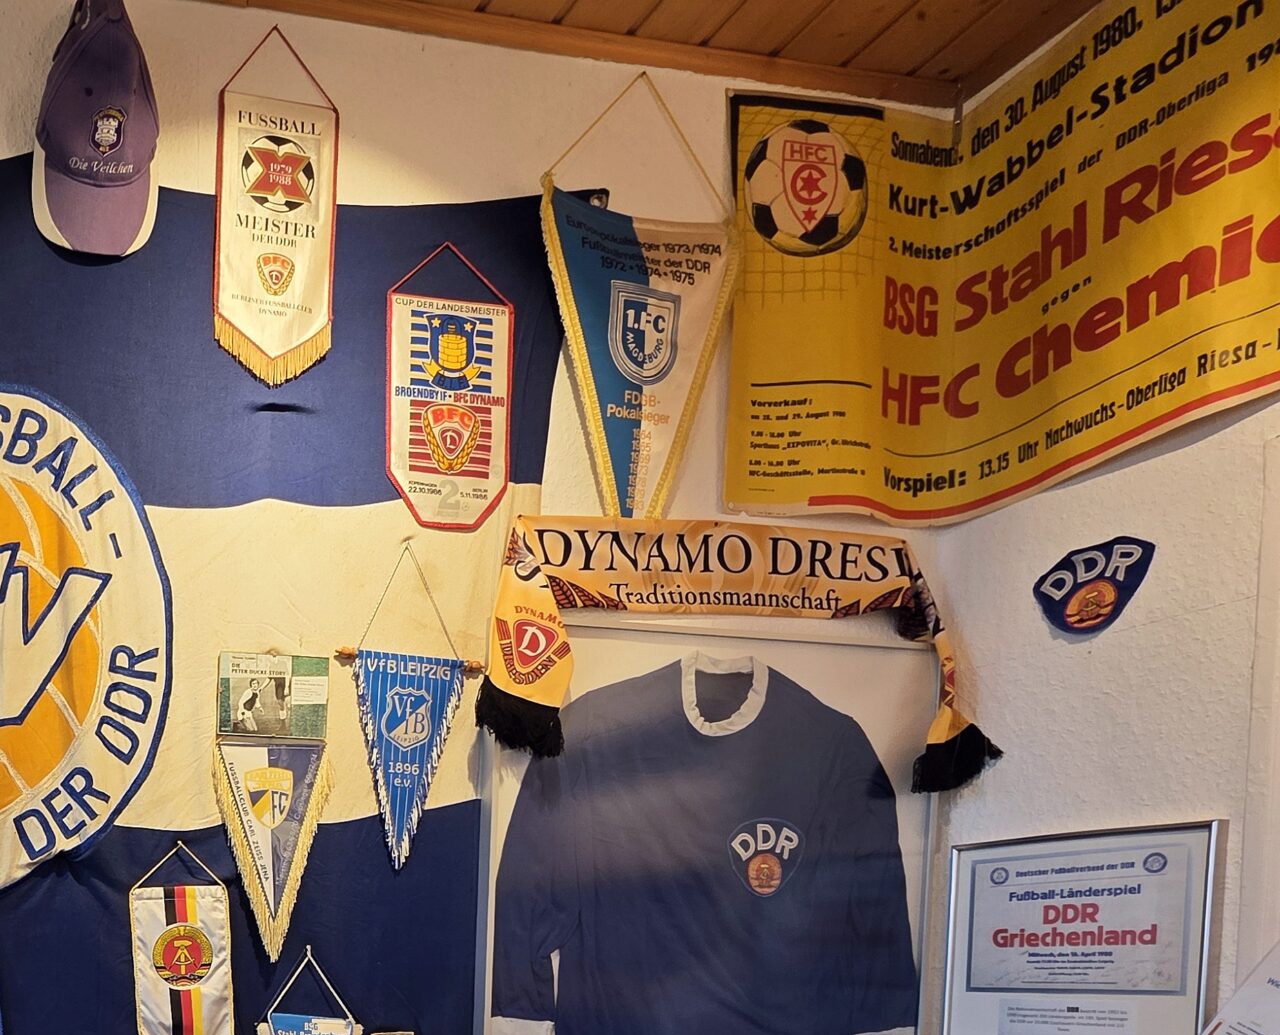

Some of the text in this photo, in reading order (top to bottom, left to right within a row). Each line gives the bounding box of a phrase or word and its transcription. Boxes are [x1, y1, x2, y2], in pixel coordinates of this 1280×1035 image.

[972, 118, 1000, 156] den
[1004, 100, 1028, 134] 30.
[1031, 46, 1087, 112] August
[1093, 6, 1143, 61] 1980,
[237, 109, 321, 136] FUSSBALL
[69, 157, 134, 174] Die Veilchen
[789, 143, 828, 162] HFC
[889, 237, 898, 253] 2.
[902, 168, 1065, 260] Meisterschaftsspiel
[1078, 149, 1103, 175] der
[1115, 71, 1229, 151] DDR-Oberliga
[269, 163, 292, 175] 1979
[269, 174, 292, 185] 1988
[235, 213, 316, 239] MEISTER
[883, 113, 1280, 338] BSG Stahl Ries
[252, 233, 297, 248] DER DDR
[664, 258, 711, 274] der DDR
[395, 297, 507, 317] CUP DER LANDESMEISTER
[1041, 274, 1093, 316] gegen
[395, 386, 505, 407] BROENDBY IF BFC DYNAMO
[881, 362, 980, 426] HFC
[433, 406, 473, 426] BFC
[606, 403, 671, 426] Pokalsieger
[883, 466, 968, 498] Vorspiel:
[978, 450, 1010, 481] 13.15
[1017, 439, 1040, 464] Uhr
[1044, 366, 1189, 451] Nachwuchs-Oberliga
[1196, 338, 1257, 379] Riesa
[533, 527, 753, 578] DYNAMO
[1040, 544, 1143, 601] DDR
[609, 582, 842, 613] Traditionsmannschaft
[514, 603, 566, 630] DYNAMO
[366, 657, 451, 681] VfB LEIPZIG
[498, 639, 557, 687] DRESDEN
[13, 765, 110, 860] DER
[93, 644, 160, 766] DDR
[387, 760, 420, 776] 1896
[731, 823, 799, 861] DDR
[1009, 883, 1142, 902] Fußball-Länderspiel
[1042, 902, 1100, 925] DDR
[992, 923, 1158, 949] Griechenland
[304, 1022, 318, 1031] BSG
